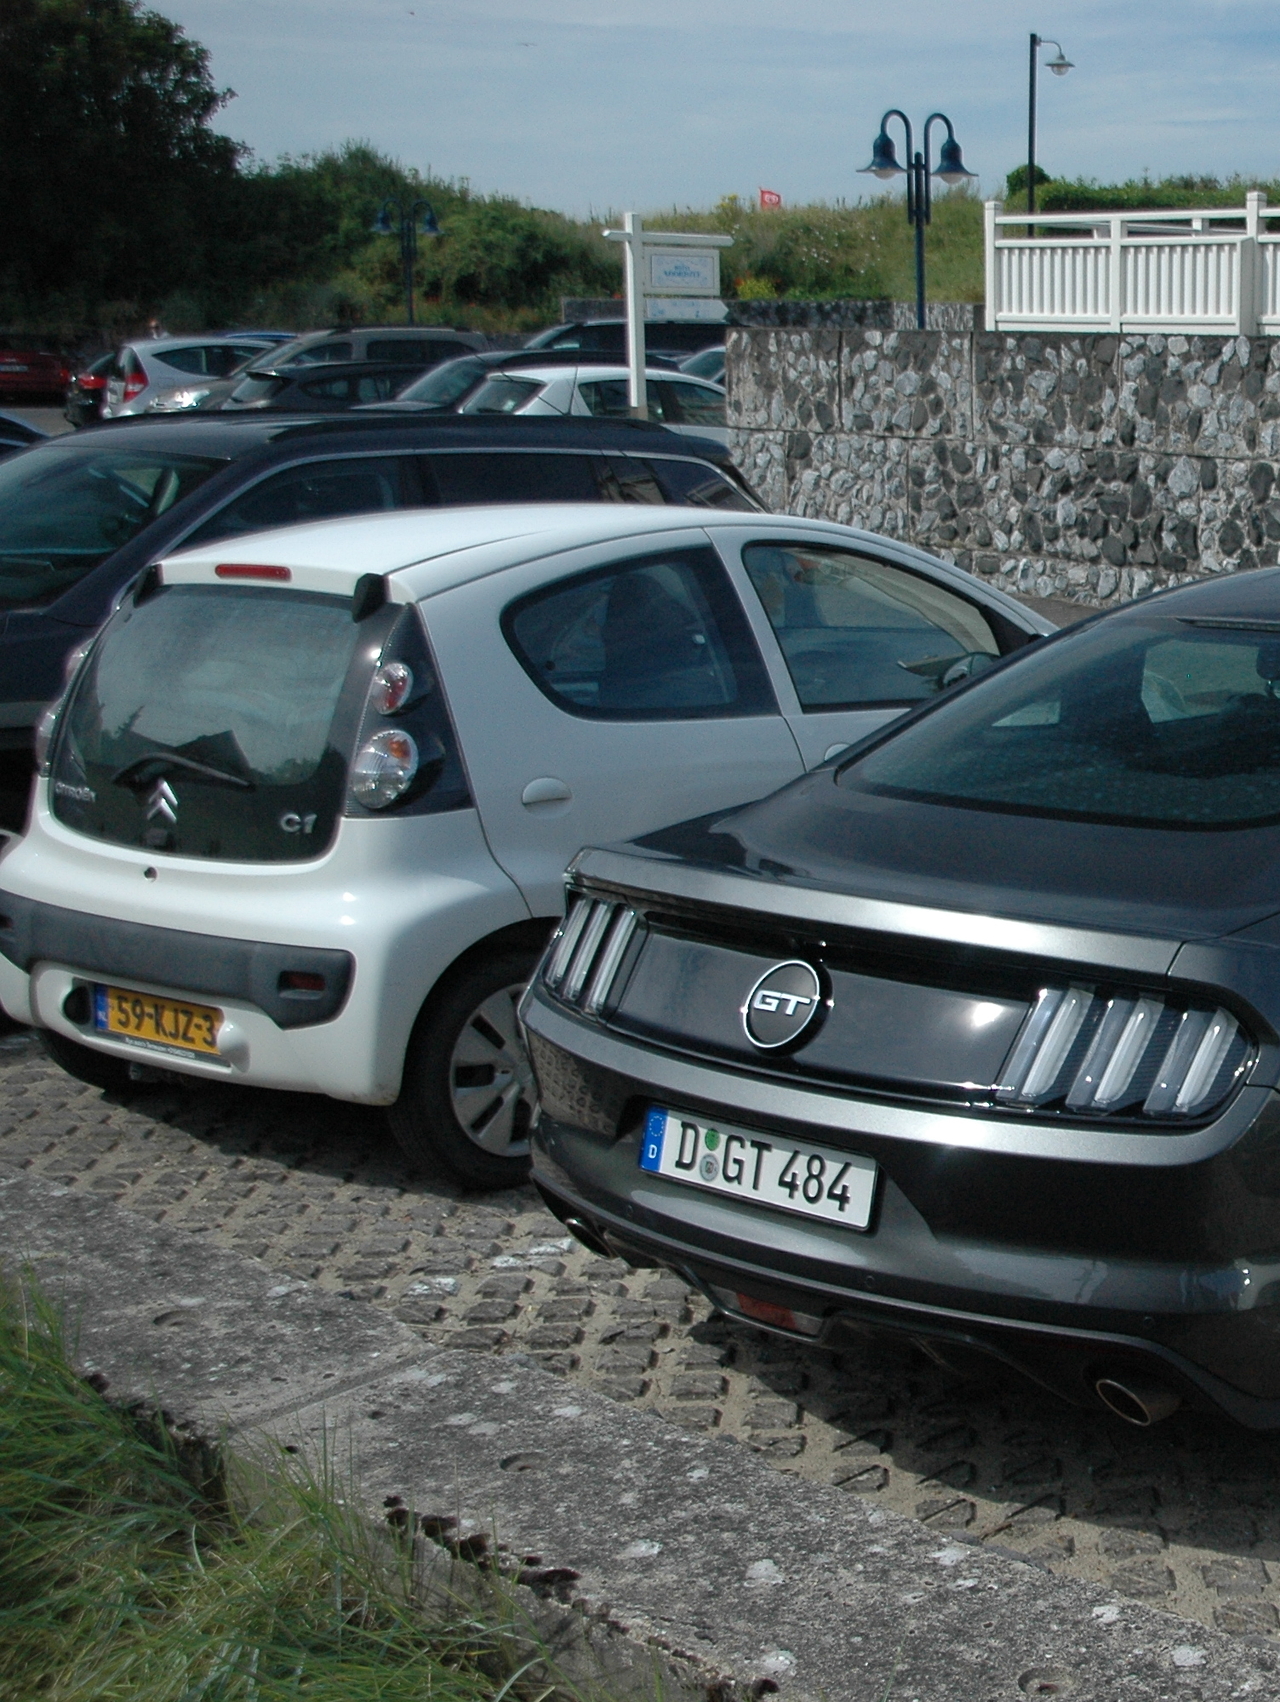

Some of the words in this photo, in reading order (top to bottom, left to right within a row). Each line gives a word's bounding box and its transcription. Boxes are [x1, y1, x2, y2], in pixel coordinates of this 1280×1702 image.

[281, 813, 318, 834] C1
[754, 990, 811, 1016] GT
[116, 995, 218, 1048] 59-KJZ-3
[648, 1144, 658, 1159] D
[675, 1121, 700, 1171] D
[722, 1134, 773, 1191] GT
[778, 1149, 852, 1213] 484
